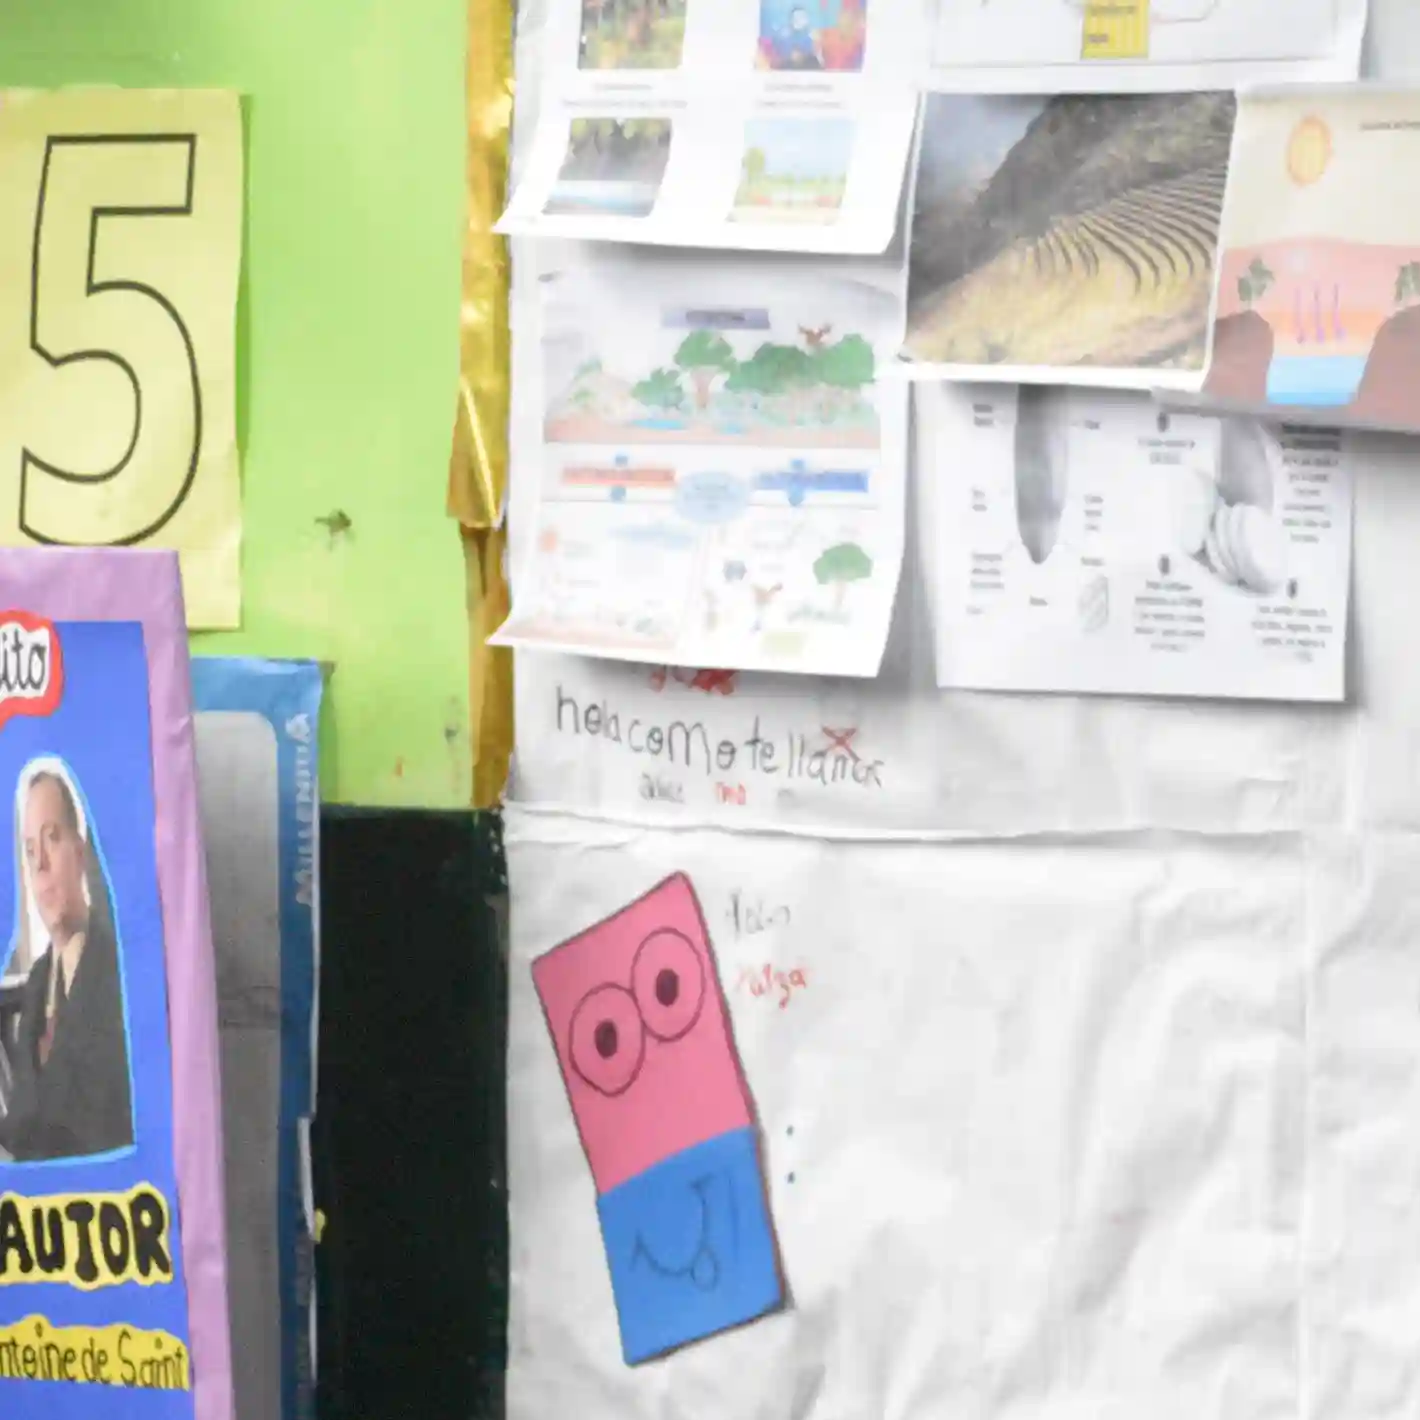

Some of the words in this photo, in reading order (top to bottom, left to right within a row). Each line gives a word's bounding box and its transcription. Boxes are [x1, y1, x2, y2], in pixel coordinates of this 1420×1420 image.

[19, 133, 202, 547] 5
[0, 1193, 171, 1282] AUTOR
[81, 1337, 114, 1384] de
